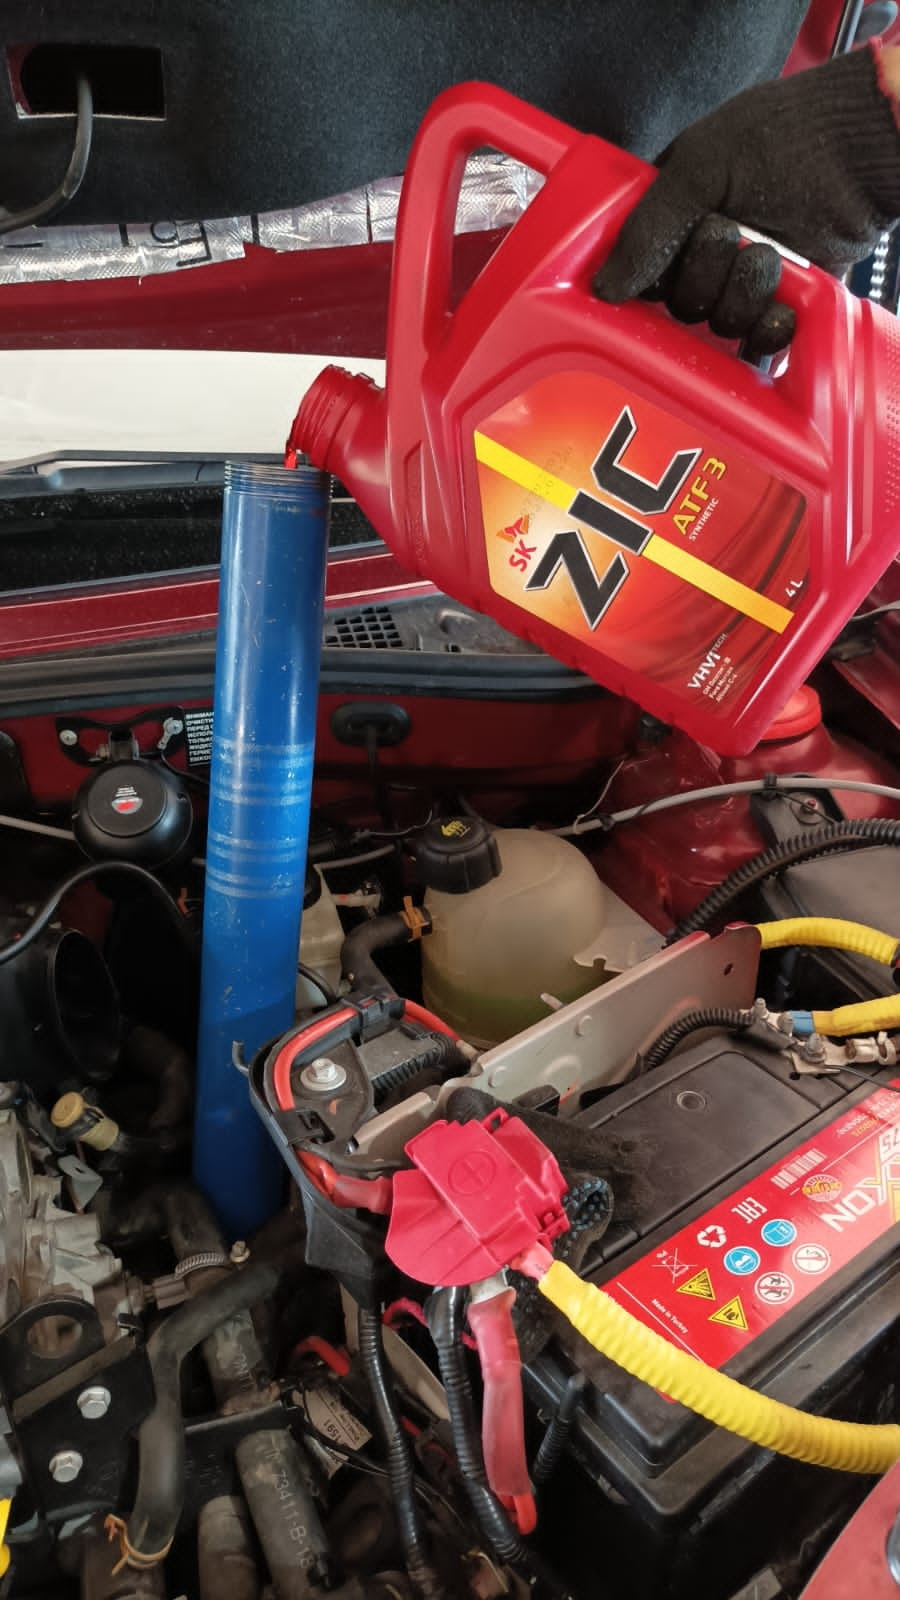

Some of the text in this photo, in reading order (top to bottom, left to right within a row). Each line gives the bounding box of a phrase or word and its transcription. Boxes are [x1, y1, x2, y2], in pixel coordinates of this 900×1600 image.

[672, 457, 727, 535] ATF 3
[523, 405, 702, 631] ZIC
[688, 497, 720, 542] SYNTHETIC
[509, 539, 537, 572] SK
[785, 580, 804, 598] 4 L
[687, 651, 721, 688] VHVI
[651, 1299, 666, 1312] Made
[671, 1315, 689, 1334] Turkey
